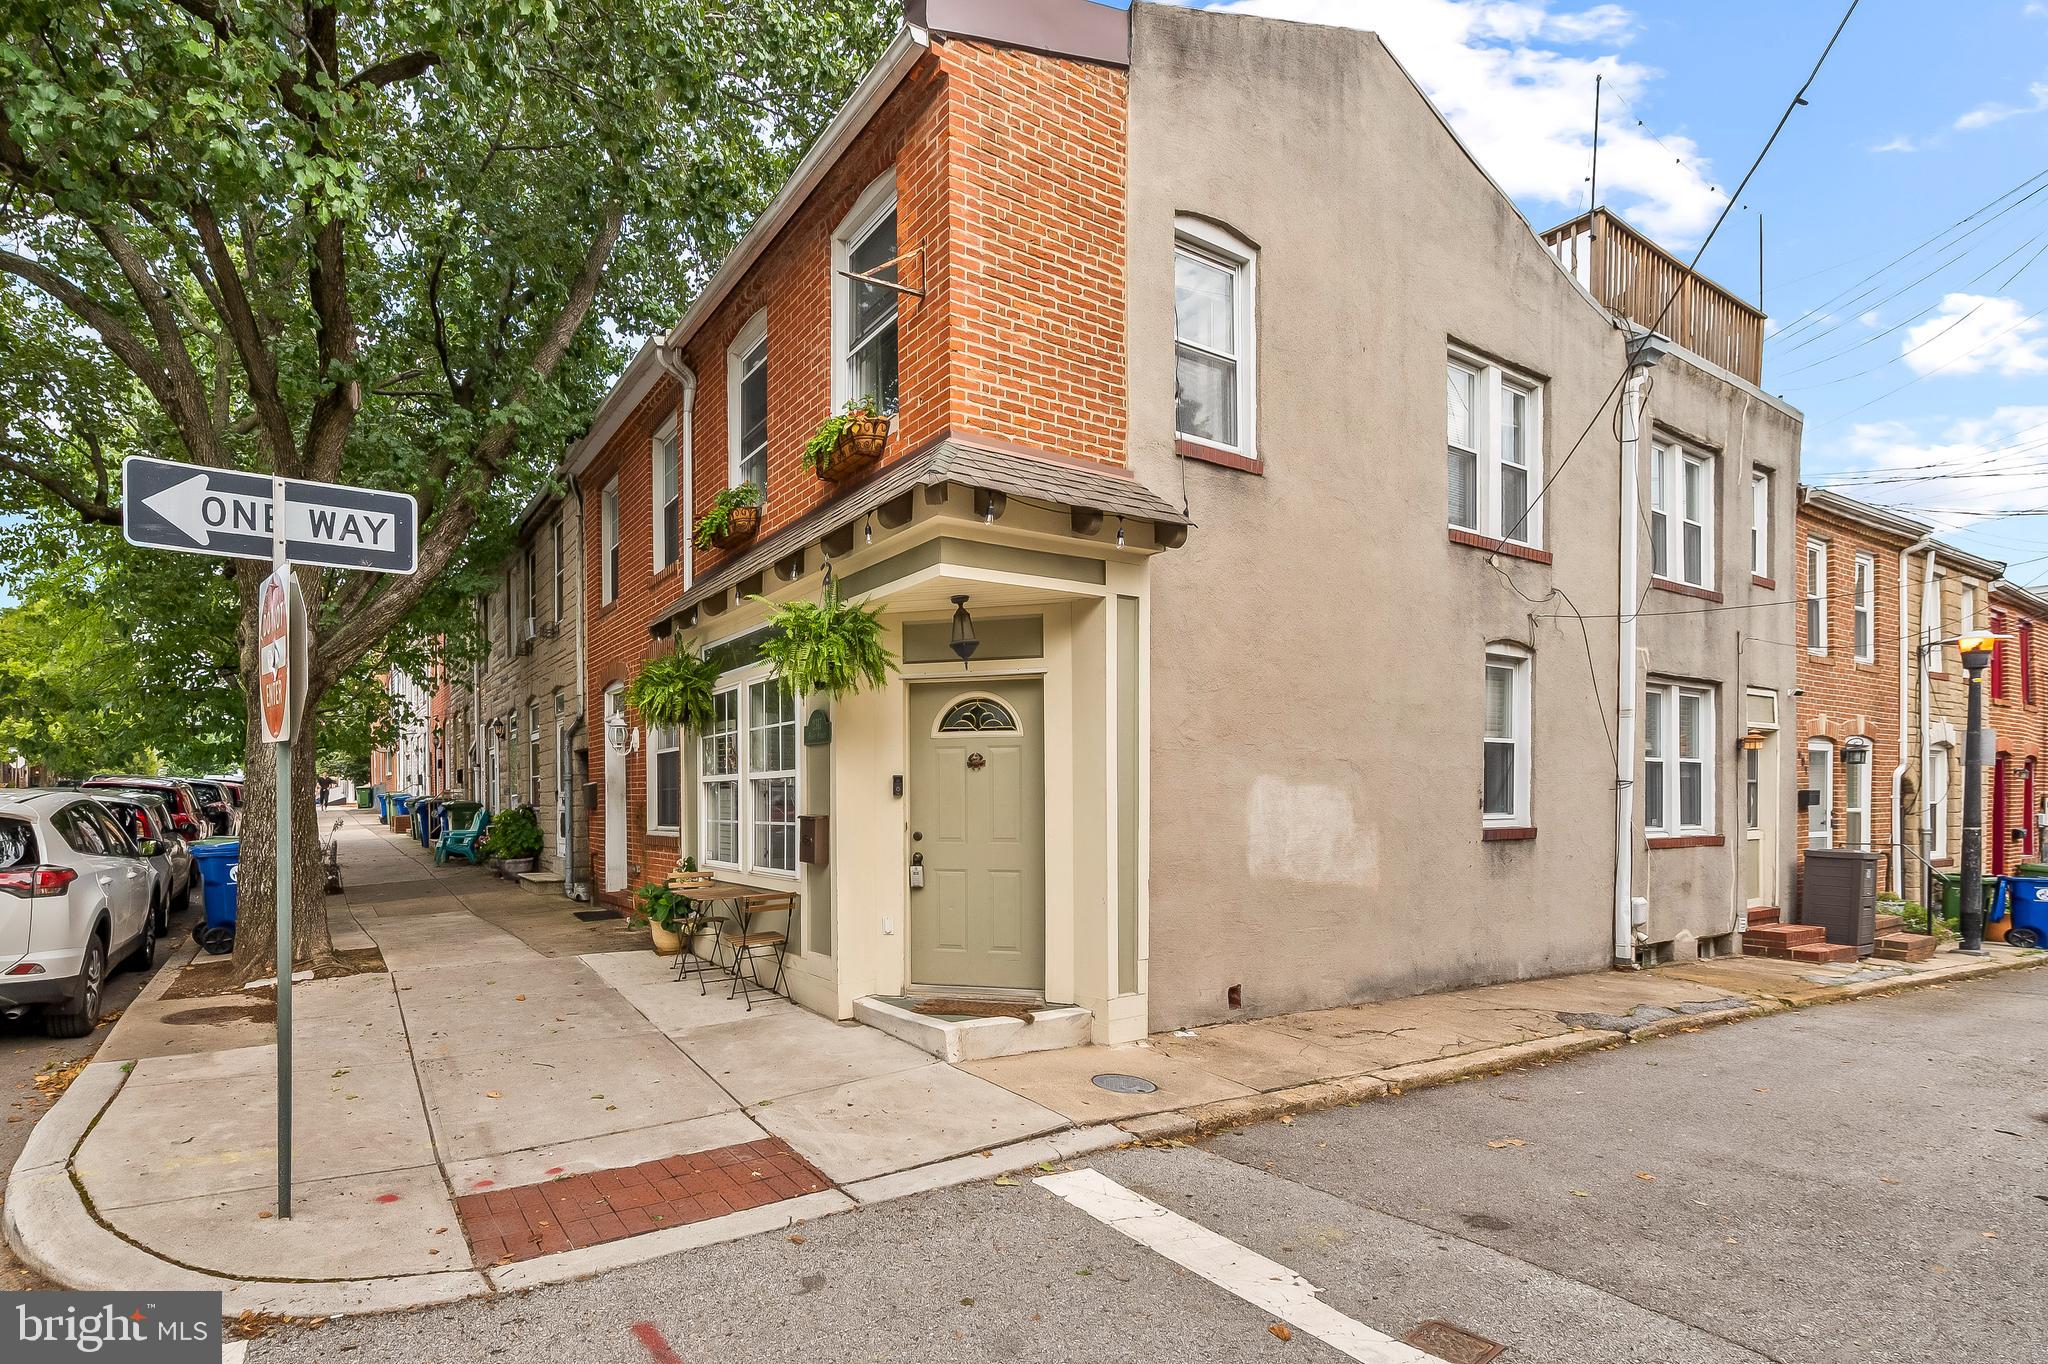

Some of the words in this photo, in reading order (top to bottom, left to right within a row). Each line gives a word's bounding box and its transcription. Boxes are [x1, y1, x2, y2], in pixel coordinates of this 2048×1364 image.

[202, 496, 273, 533] ONE
[309, 509, 388, 545] WAY
[266, 680, 282, 708] ENTER
